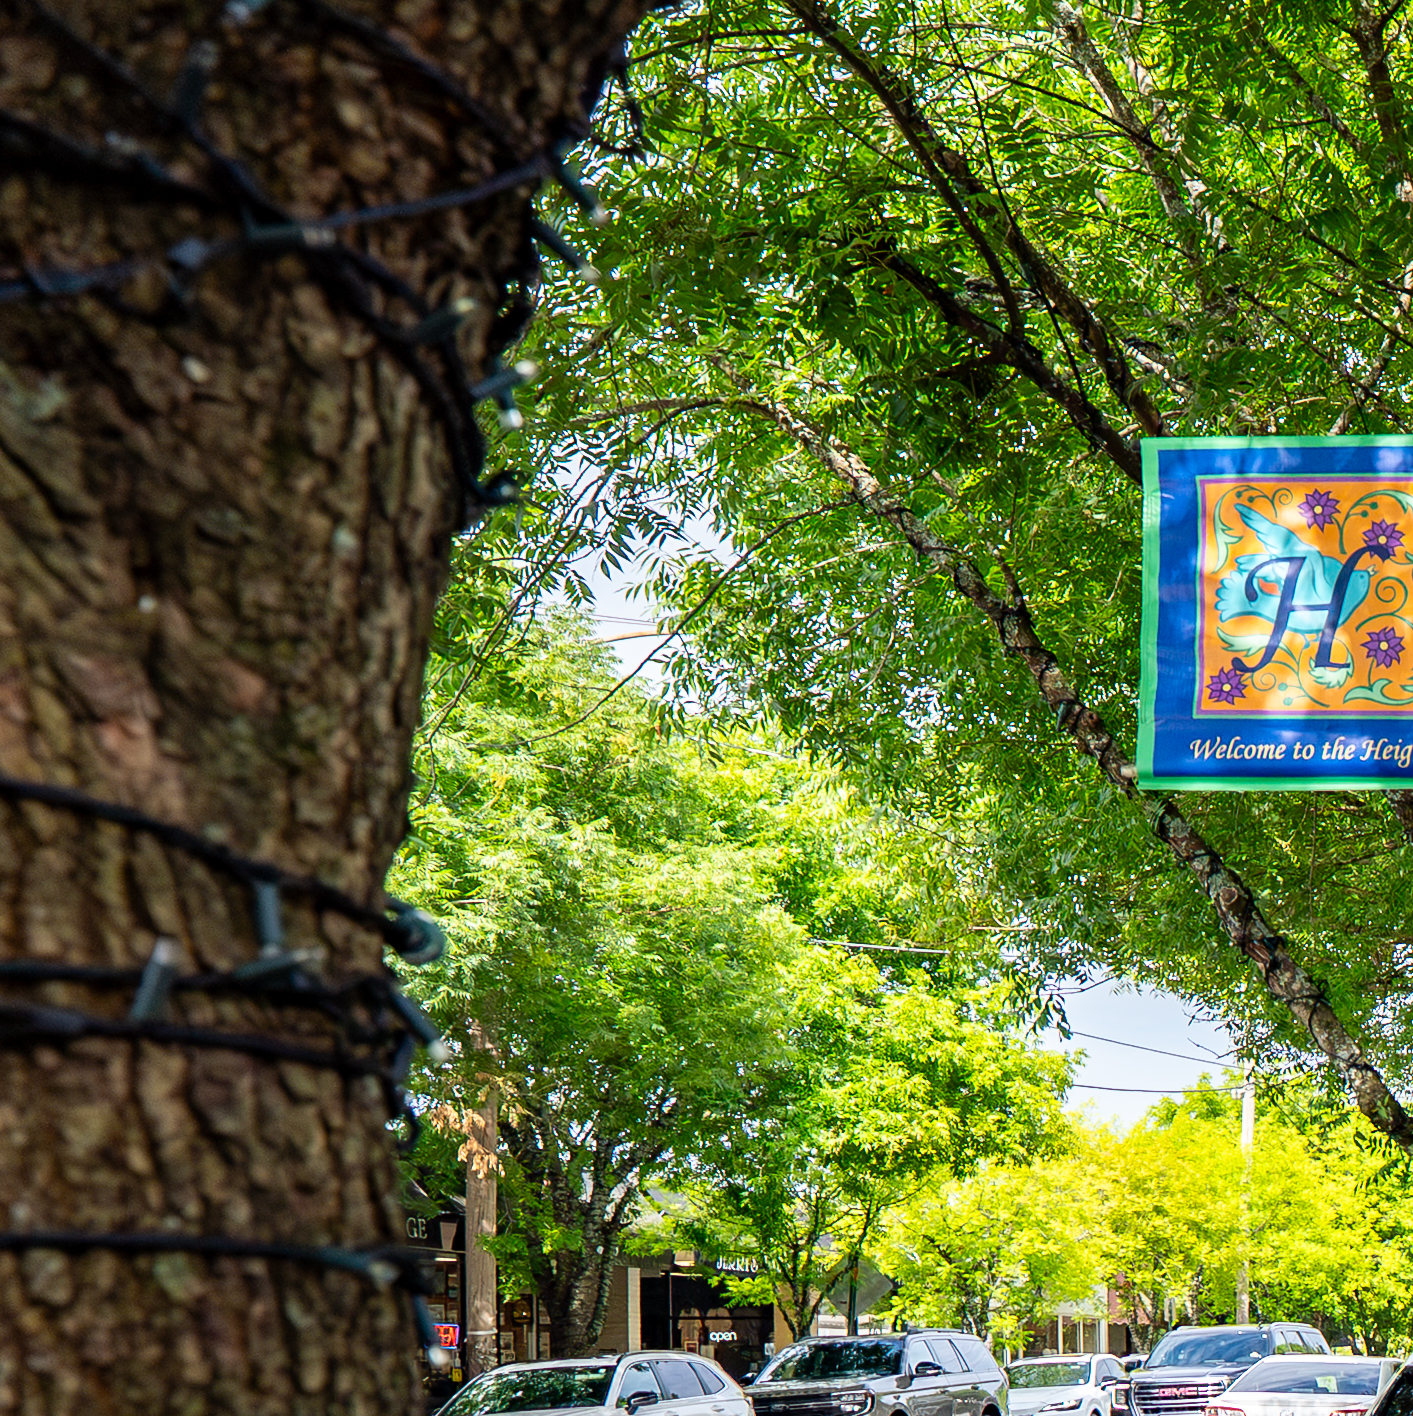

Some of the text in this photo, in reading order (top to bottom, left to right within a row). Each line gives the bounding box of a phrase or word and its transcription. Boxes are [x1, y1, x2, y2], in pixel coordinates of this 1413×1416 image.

[1231, 545, 1391, 673] H
[1189, 736, 1287, 761] Welcome
[1293, 741, 1315, 760] to
[1321, 736, 1355, 760] the
[709, 1331, 738, 1342] open
[1159, 1387, 1198, 1397] GMC
